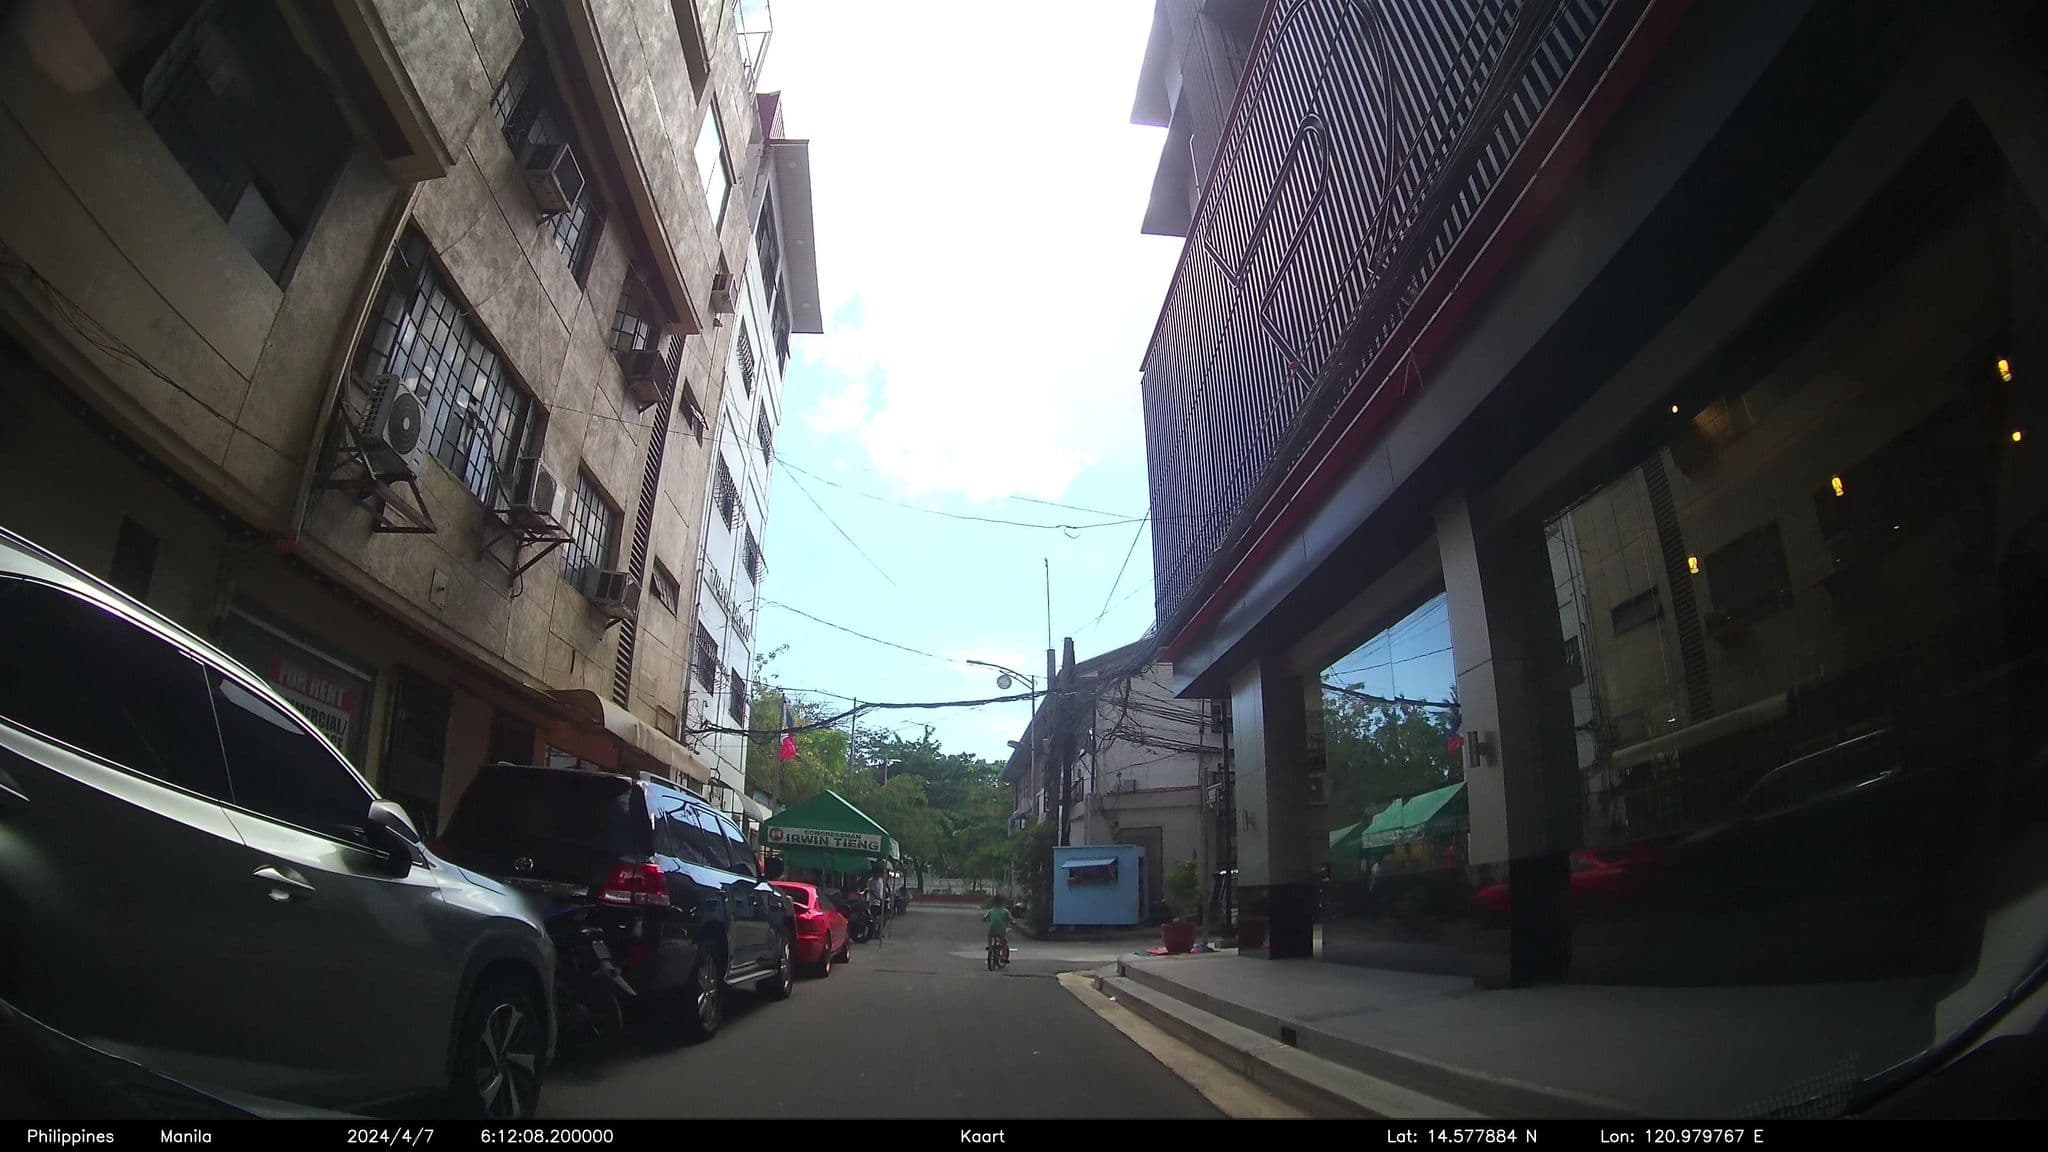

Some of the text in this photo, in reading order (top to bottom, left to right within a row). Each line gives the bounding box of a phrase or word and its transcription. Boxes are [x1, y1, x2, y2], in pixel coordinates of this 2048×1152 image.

[279, 661, 345, 708] FOR RENT
[786, 834, 879, 851] IRWIN TIENG
[804, 829, 862, 840] CONGRESSMAN
